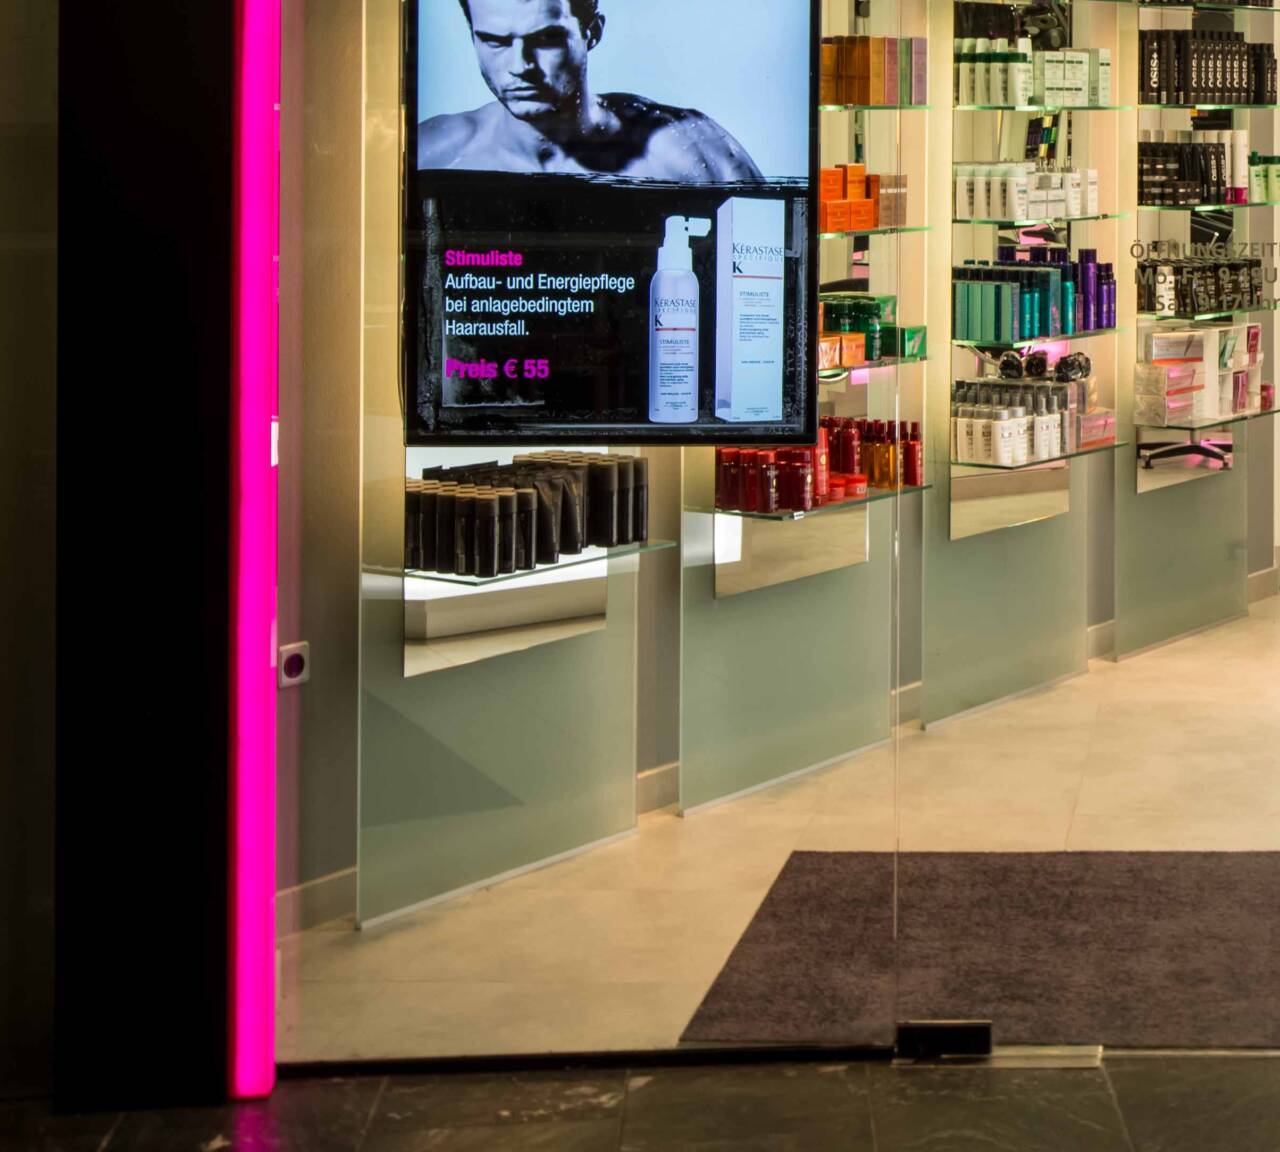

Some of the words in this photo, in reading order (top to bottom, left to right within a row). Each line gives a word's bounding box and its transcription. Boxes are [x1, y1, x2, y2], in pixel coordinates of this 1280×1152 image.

[445, 249, 523, 266] Stimuliste
[732, 261, 744, 274] K
[445, 273, 502, 290] Aufbau-
[506, 274, 535, 290] und
[538, 274, 635, 294] Energiepflege
[445, 297, 467, 313] bei
[471, 297, 594, 316] anlagebedingtem
[445, 320, 529, 336] Haarausfall.
[654, 314, 663, 327] K
[445, 359, 498, 379] Preis
[503, 359, 518, 378] €
[523, 359, 550, 378] 55
